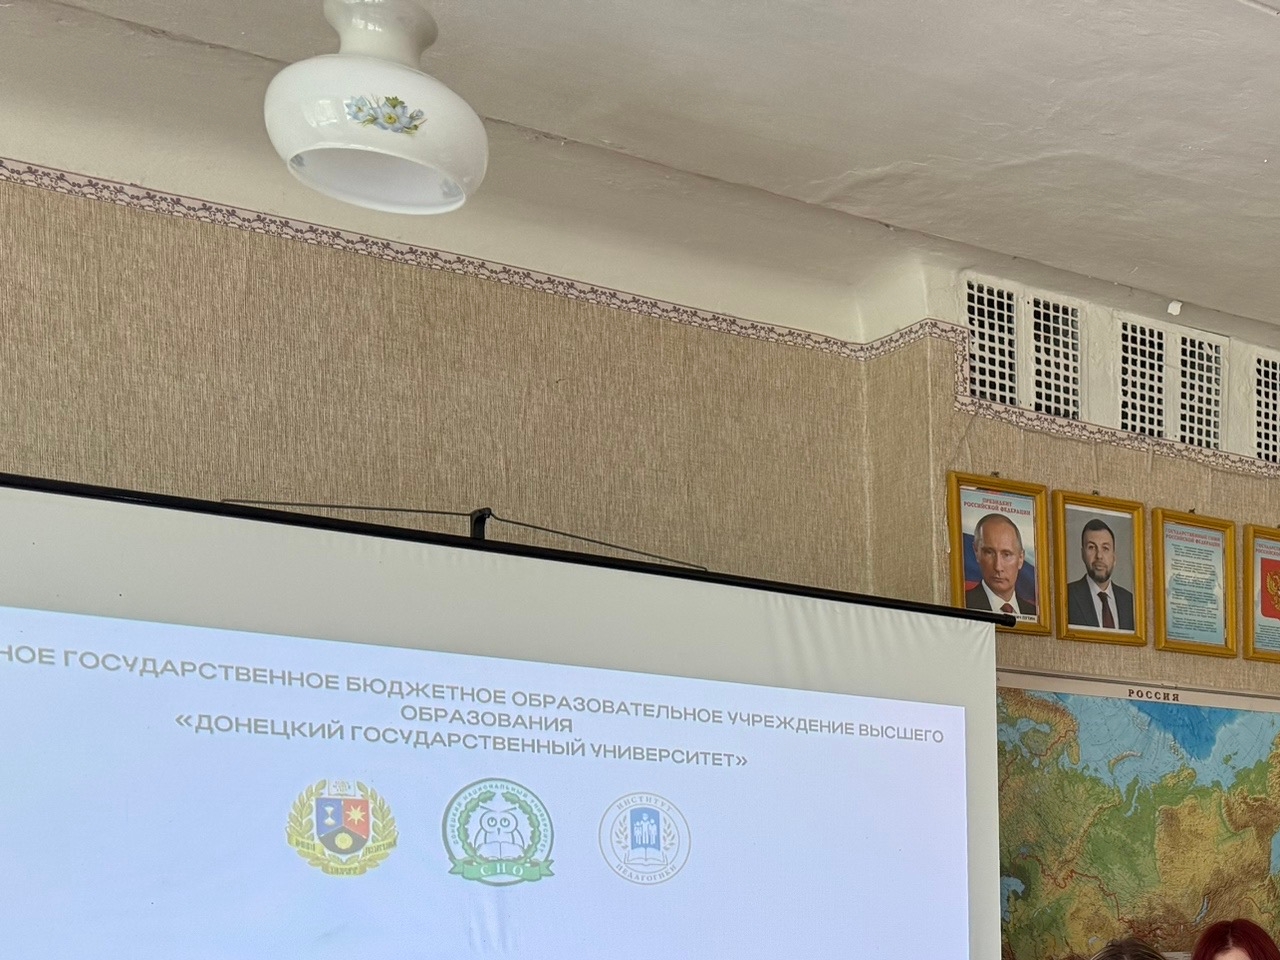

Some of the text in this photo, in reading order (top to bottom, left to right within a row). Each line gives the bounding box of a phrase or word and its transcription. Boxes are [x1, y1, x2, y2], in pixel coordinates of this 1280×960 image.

[963, 501, 1031, 516] РОССИЙСКОЙ ФЕДЕРАЦИИ
[982, 498, 1012, 507] ПРЕЗИДЕНТ
[63, 649, 340, 691] ГОСУДАРСТВЕННОЕ
[346, 676, 506, 705] БЮДЖЕТНОЕ
[512, 691, 723, 723] ОБРАЗОВАТЕЛЬНОЕ
[727, 711, 855, 737] УЧРЕЖДЕНИЕ
[859, 723, 944, 744] ВЫСШЕГО
[1128, 688, 1180, 702] РОССИЯ
[401, 704, 573, 733] ОБРАЗОВАНИЯ
[175, 713, 748, 768] «ДОНЕЦКИЙ ГОСУДАРСТВЕННЫЙ УНИВЕРСИТЕТ»
[616, 795, 673, 812] ИНСТИТУТ
[480, 862, 523, 876] СНО
[615, 863, 677, 882] ПЕДАГОГИКИ
